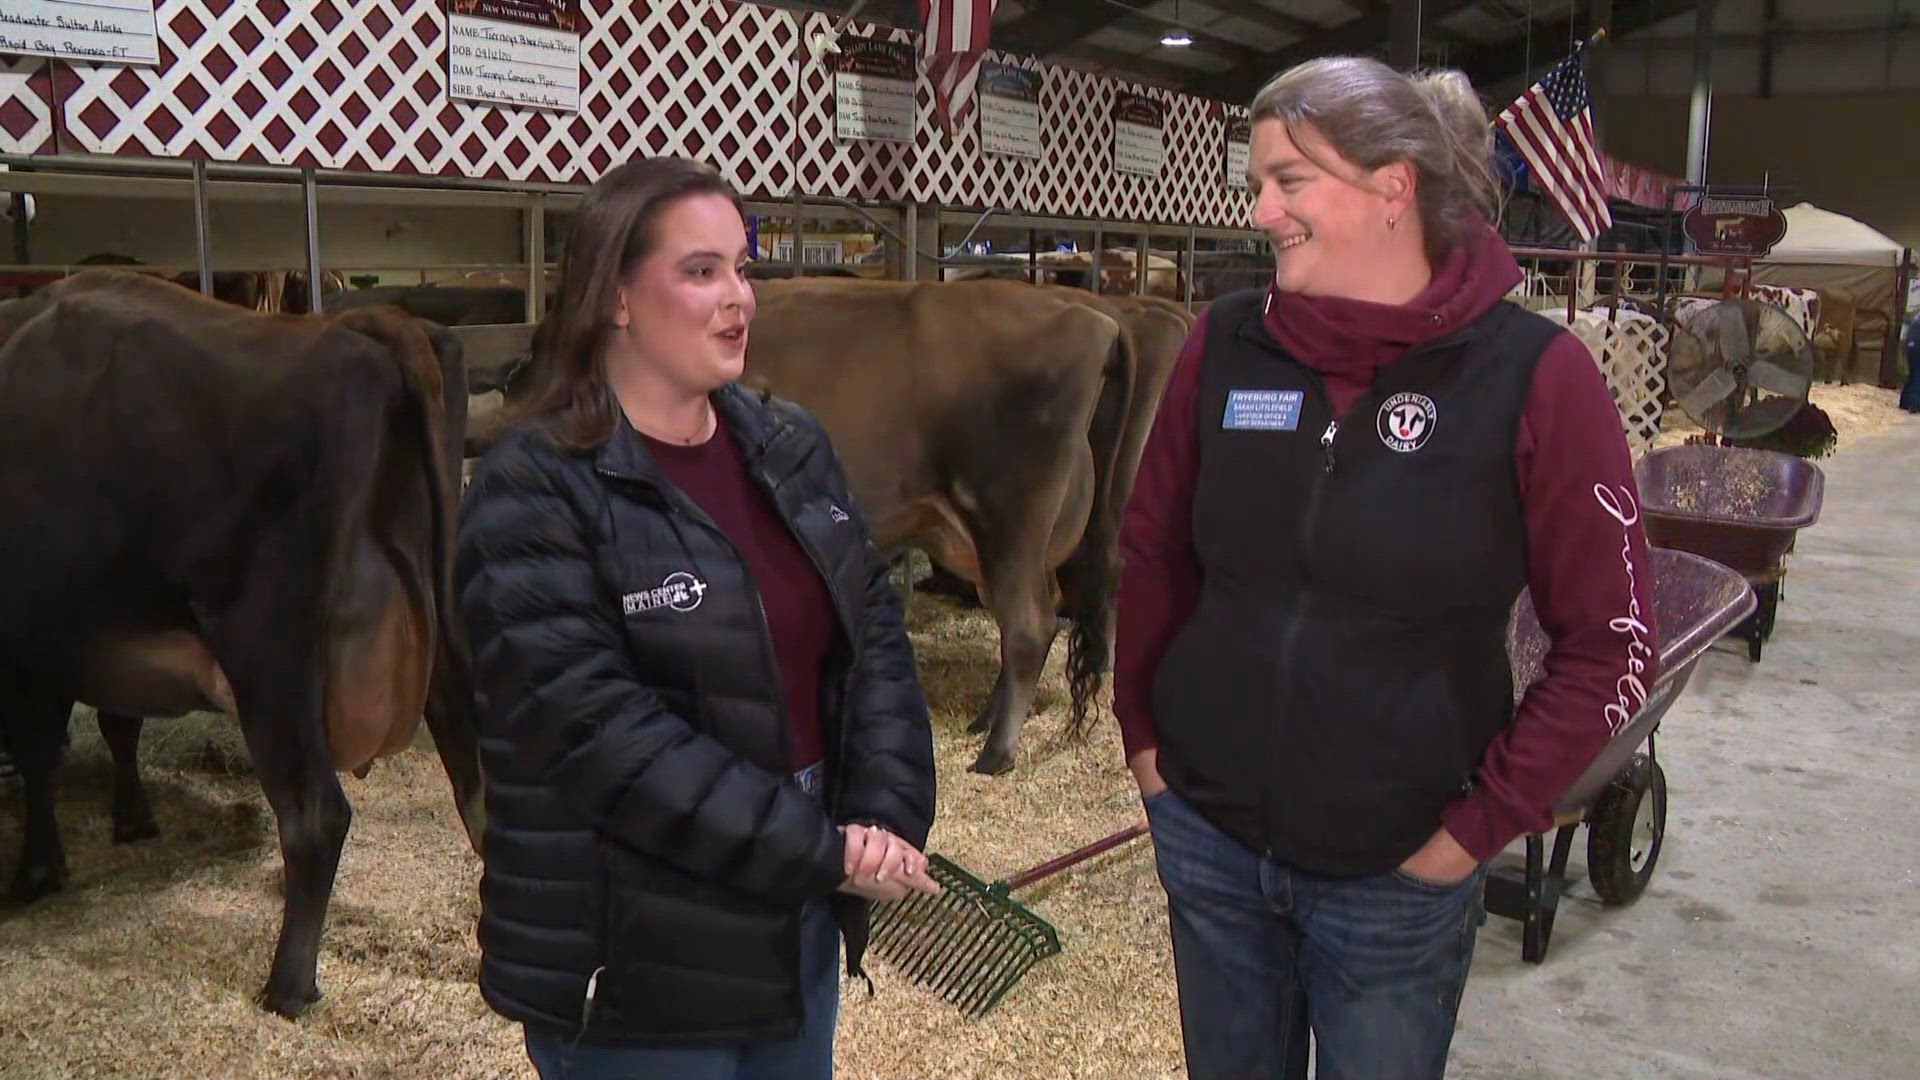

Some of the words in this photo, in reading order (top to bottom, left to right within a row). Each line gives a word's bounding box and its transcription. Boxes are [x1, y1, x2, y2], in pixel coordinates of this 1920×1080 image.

[482, 2, 500, 13] NEW
[538, 11, 551, 23] ME
[56, 15, 89, 30] Sultan
[93, 19, 123, 33] Alaska
[35, 39, 56, 55] Bay
[1232, 392, 1277, 402] FRYEBURG
[1278, 392, 1298, 402] FAIR
[1233, 403, 1254, 411] SARAH
[1383, 394, 1434, 419] UNDENIABLY
[1386, 435, 1417, 451] DAIRY
[622, 590, 650, 605] NEWS
[651, 582, 687, 598] CENTER
[624, 591, 673, 614] MAINE
